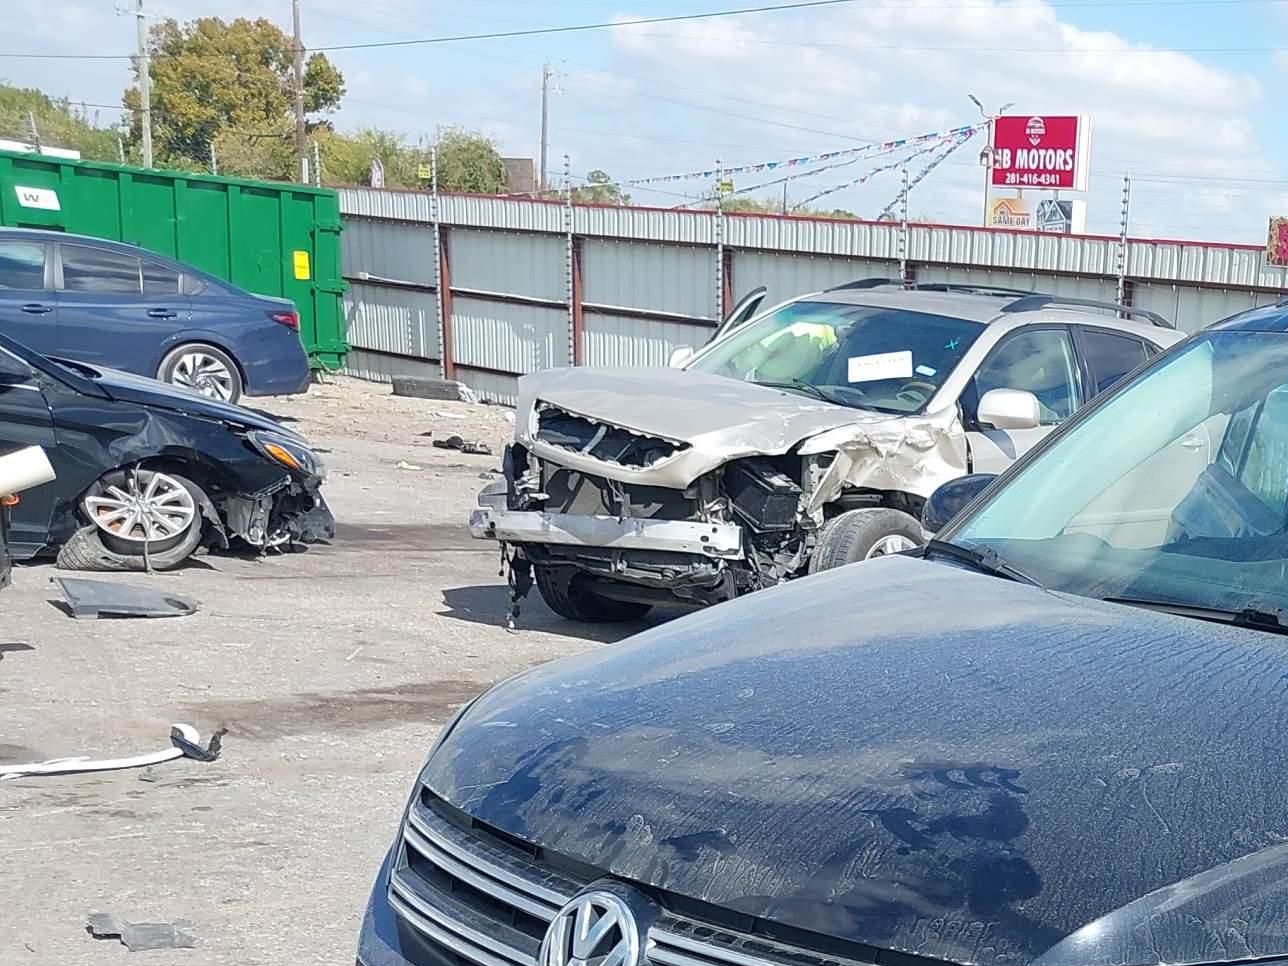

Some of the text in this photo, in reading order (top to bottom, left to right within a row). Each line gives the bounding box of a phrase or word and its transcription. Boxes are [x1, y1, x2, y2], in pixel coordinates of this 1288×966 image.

[1015, 148, 1073, 171] MOTORS
[1005, 172, 1060, 185] 281-416-4341
[992, 215, 1031, 226] SAME DAY
